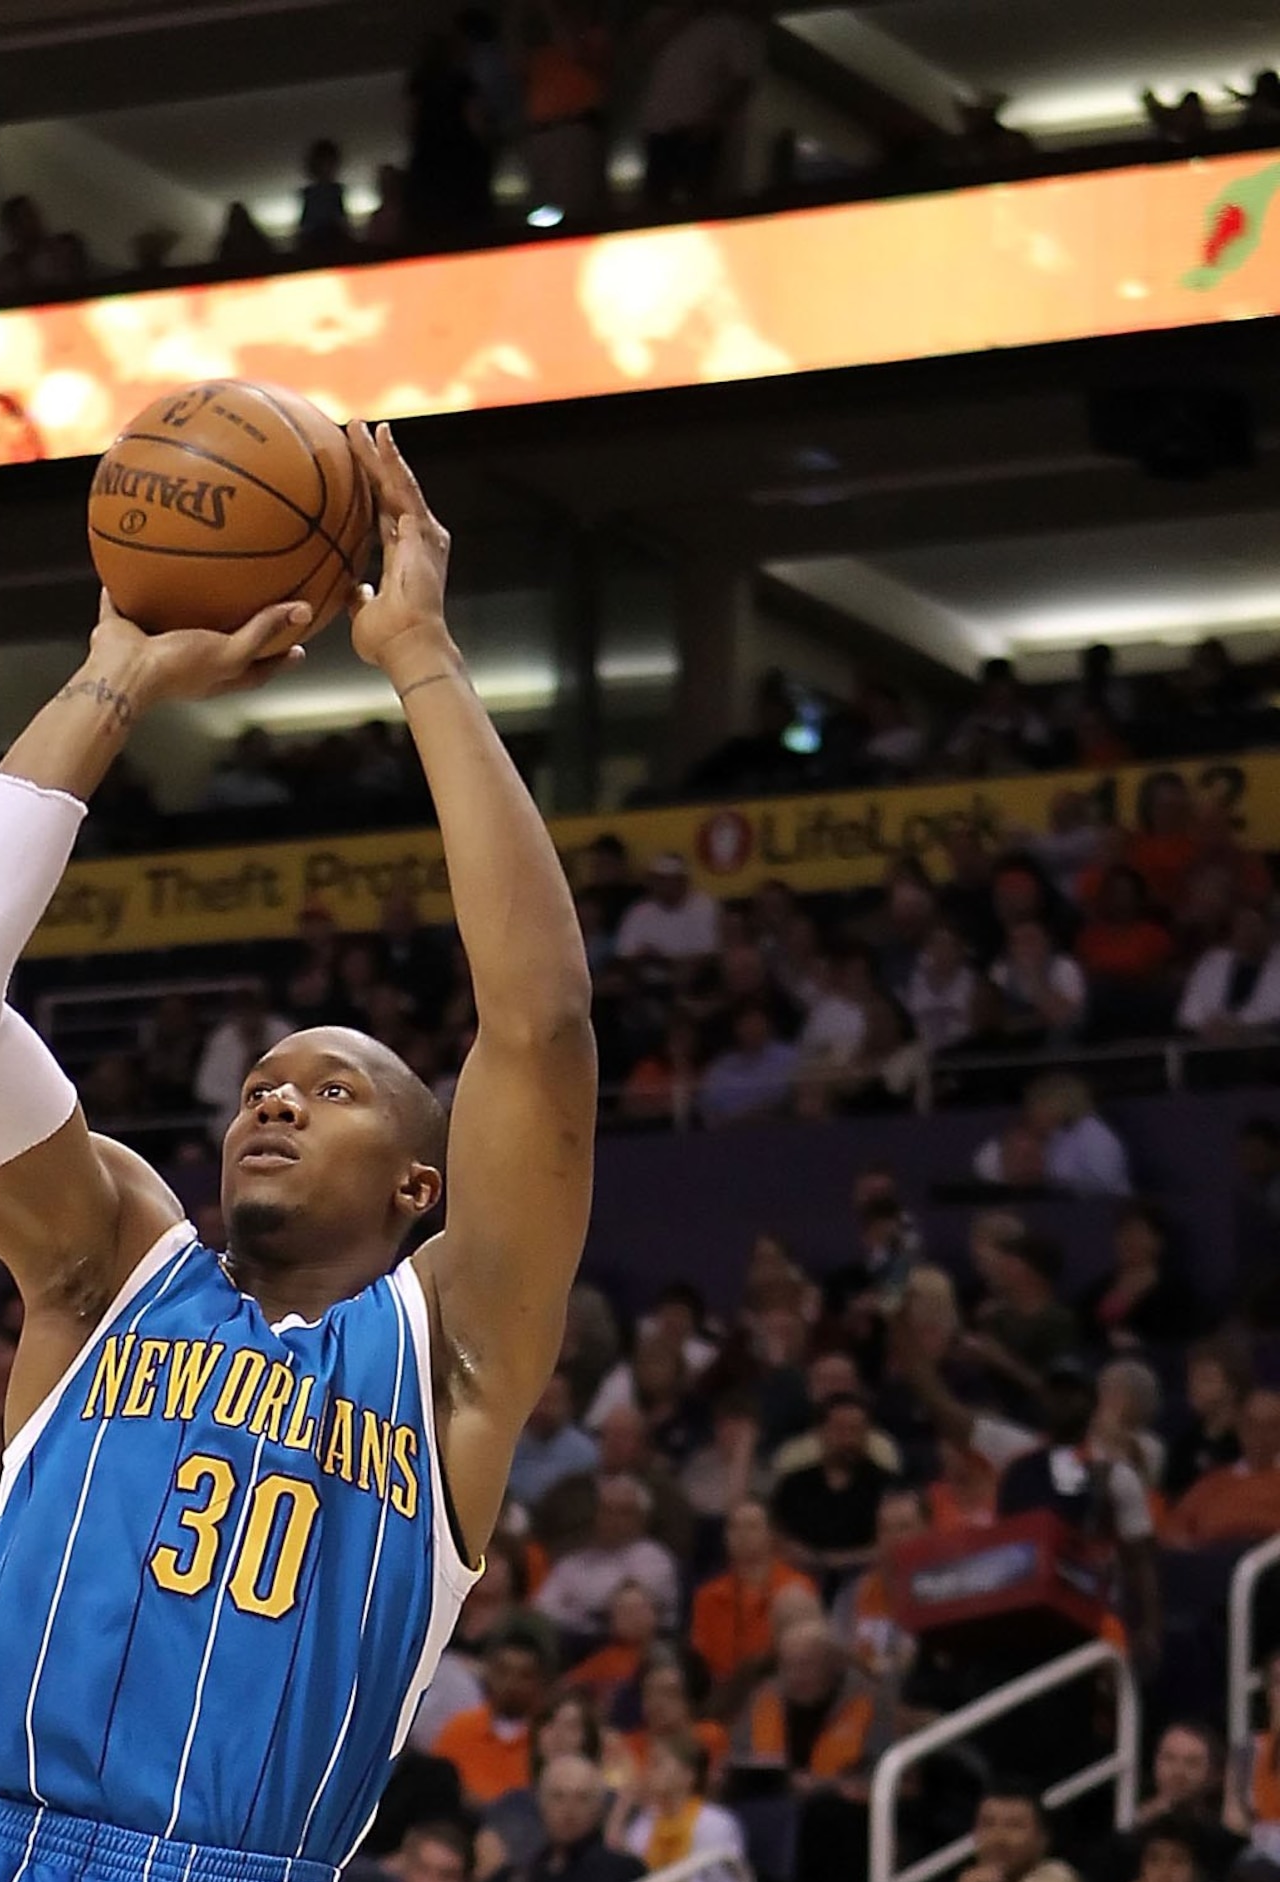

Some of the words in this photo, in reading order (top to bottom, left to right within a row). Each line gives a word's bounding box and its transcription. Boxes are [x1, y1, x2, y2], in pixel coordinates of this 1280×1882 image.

[94, 461, 236, 530] SPALDIN
[80, 1332, 224, 1421] NEW
[212, 1348, 419, 1521] ORLANS
[148, 1453, 322, 1622] 30
